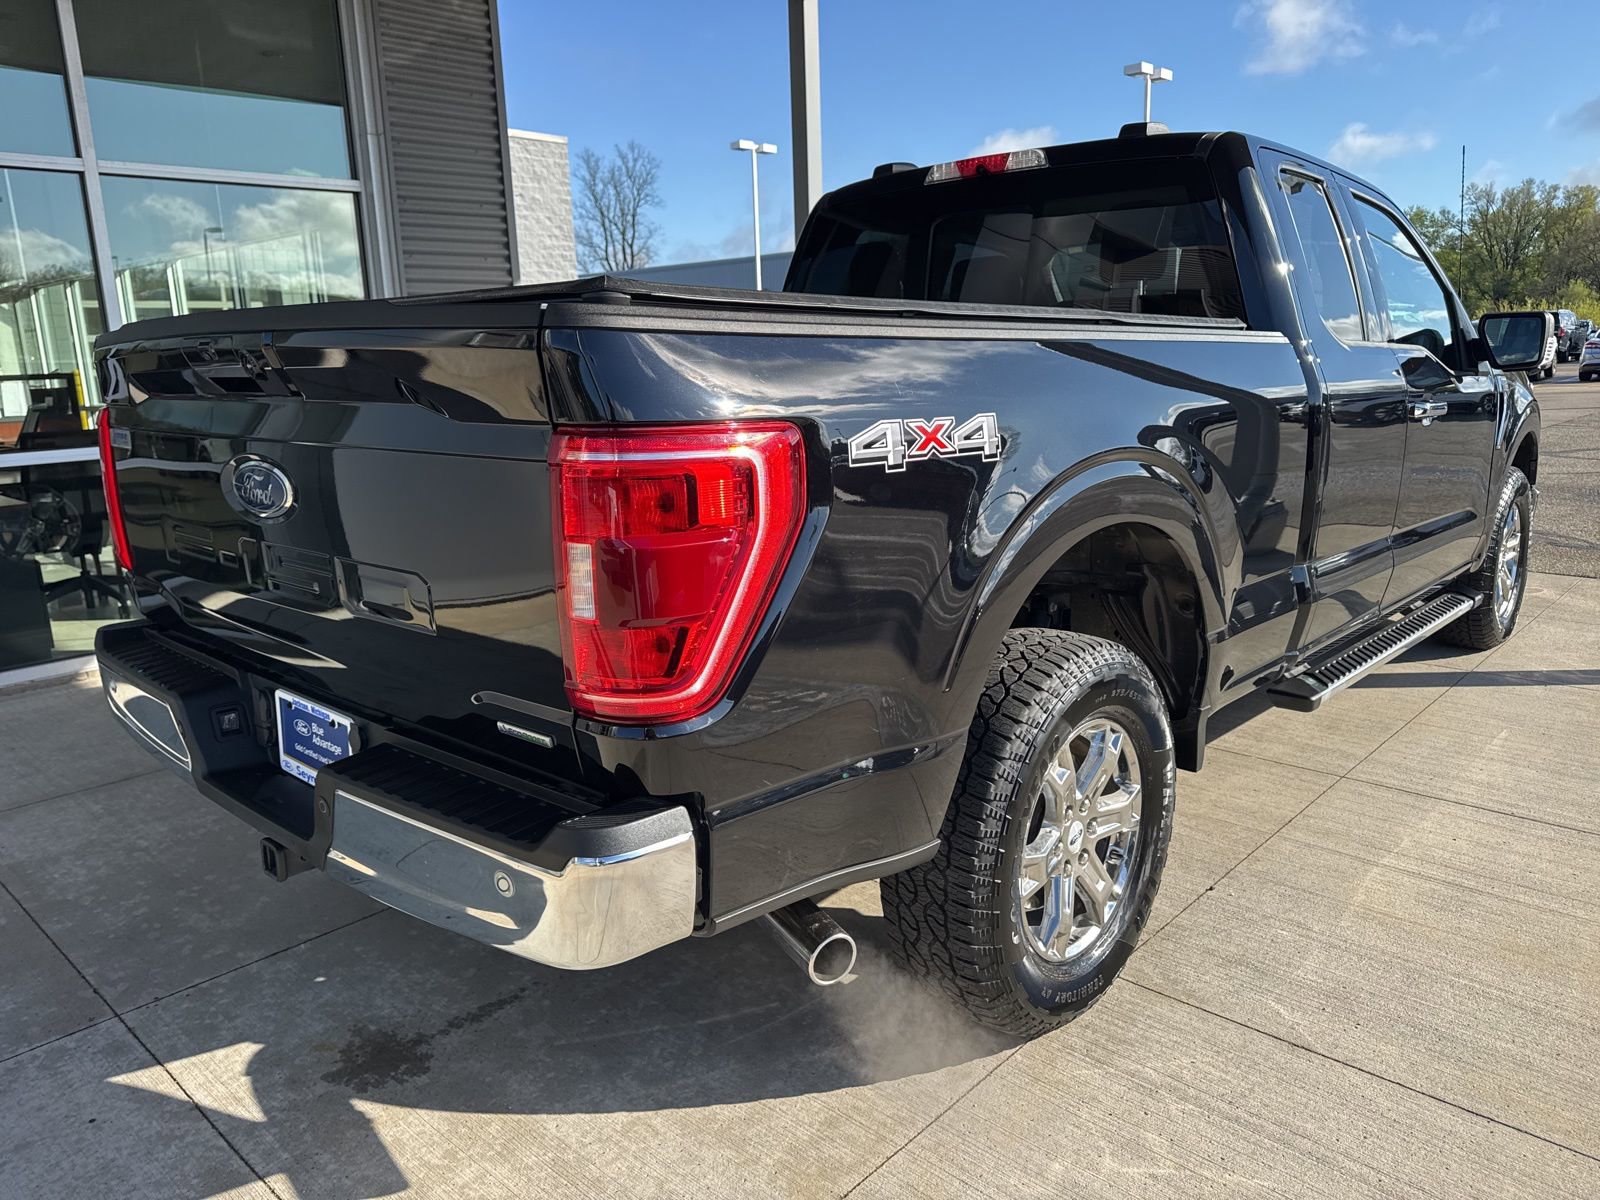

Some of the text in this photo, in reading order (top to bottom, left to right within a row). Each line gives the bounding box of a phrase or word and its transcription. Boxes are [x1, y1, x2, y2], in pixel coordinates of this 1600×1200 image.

[241, 472, 273, 505] Ford
[312, 722, 325, 737] Blue
[312, 734, 343, 756] Advantage
[1055, 974, 1104, 1004] TERRITORY
